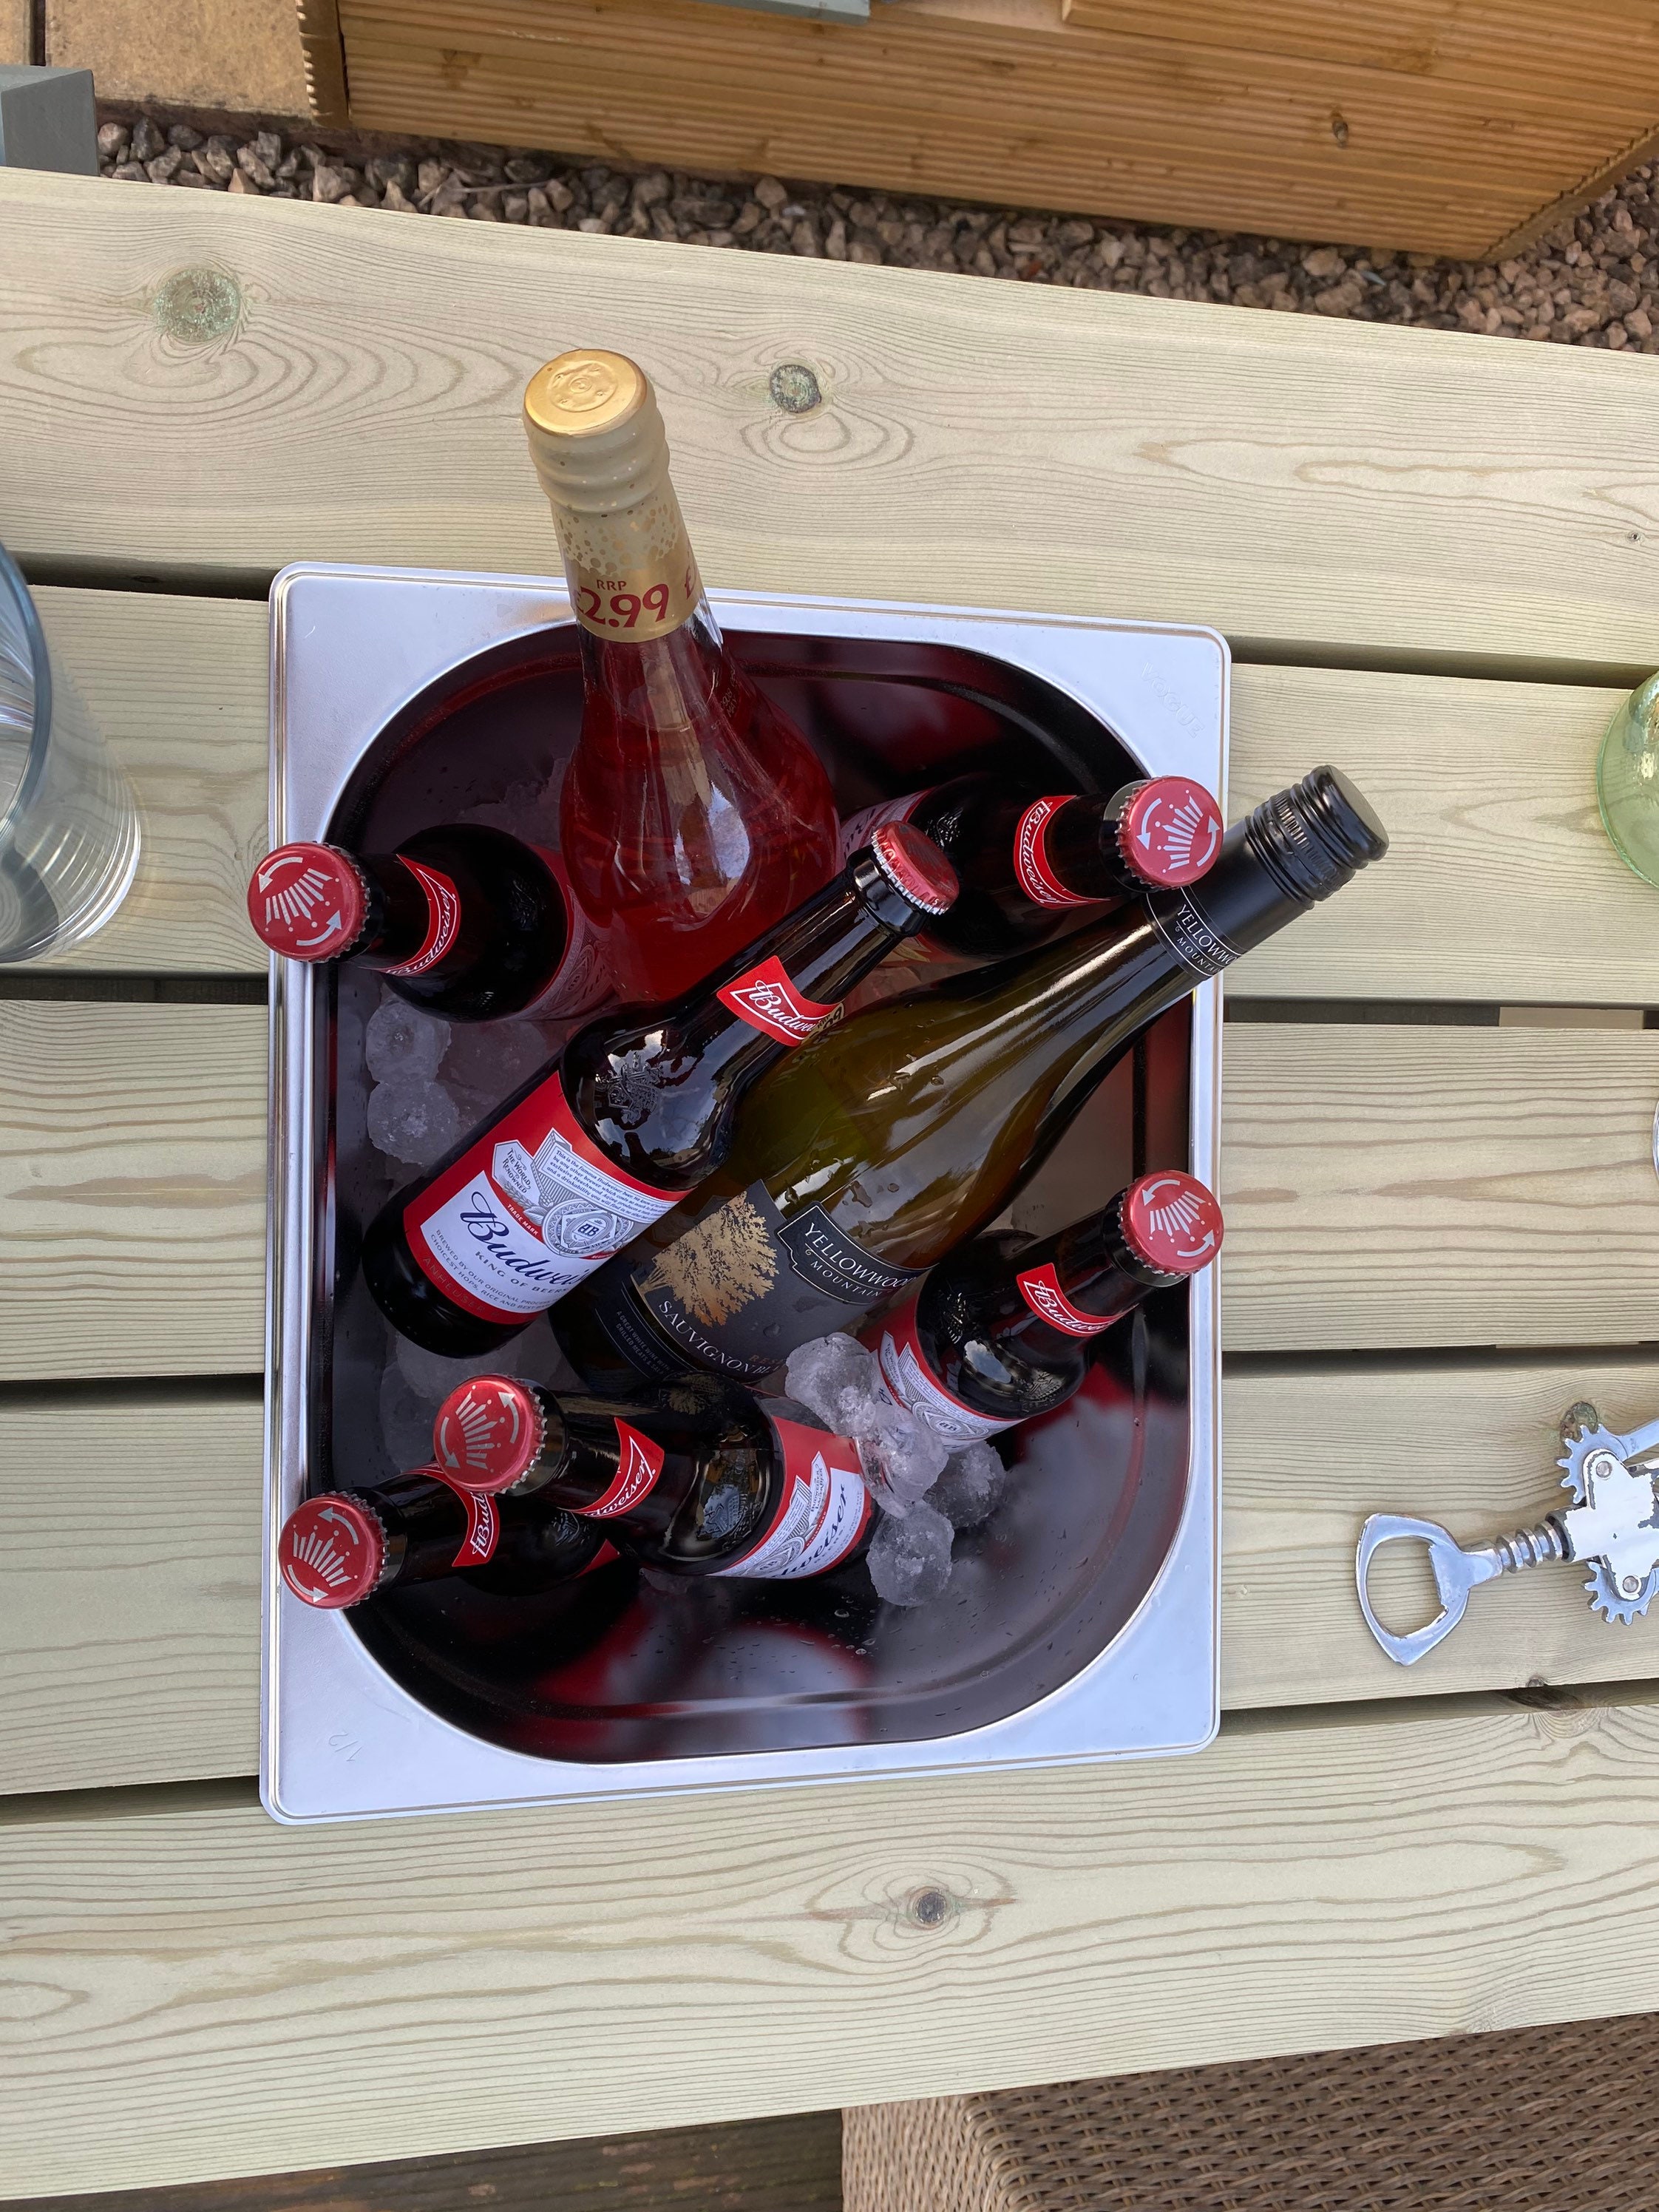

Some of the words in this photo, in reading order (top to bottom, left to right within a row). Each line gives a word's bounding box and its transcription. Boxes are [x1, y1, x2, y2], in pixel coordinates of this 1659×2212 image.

[596, 578, 628, 591] RRP
[1141, 662, 1205, 739] VOGUE
[501, 1157, 527, 1194] RENOWNED
[506, 1147, 516, 1164] THE
[512, 1161, 532, 1187] WORLD
[555, 1150, 566, 1159] This
[570, 1159, 580, 1168] the
[569, 1167, 583, 1177] other
[506, 1204, 523, 1221] TRADE
[522, 1221, 538, 1235] MARK
[577, 1220, 600, 1240] AB
[430, 1233, 458, 1271] CHOICEST
[480, 1289, 499, 1302] RICE
[499, 1298, 517, 1309] AND
[435, 1228, 459, 1261] BREWED
[458, 1261, 469, 1272] BY
[467, 1269, 484, 1285] OUR
[484, 1283, 520, 1303] ORIGINAL
[475, 1250, 506, 1278] KING
[509, 1275, 529, 1289] OF
[810, 1260, 883, 1297] MOUNTAIN
[615, 1322, 634, 1346] GRILLED
[631, 1343, 648, 1362] MEATS
[619, 1314, 634, 1334] GREAT
[631, 1331, 647, 1349] WHITE
[643, 1346, 659, 1361] WINE
[659, 1299, 758, 1374] SAUVIGNON
